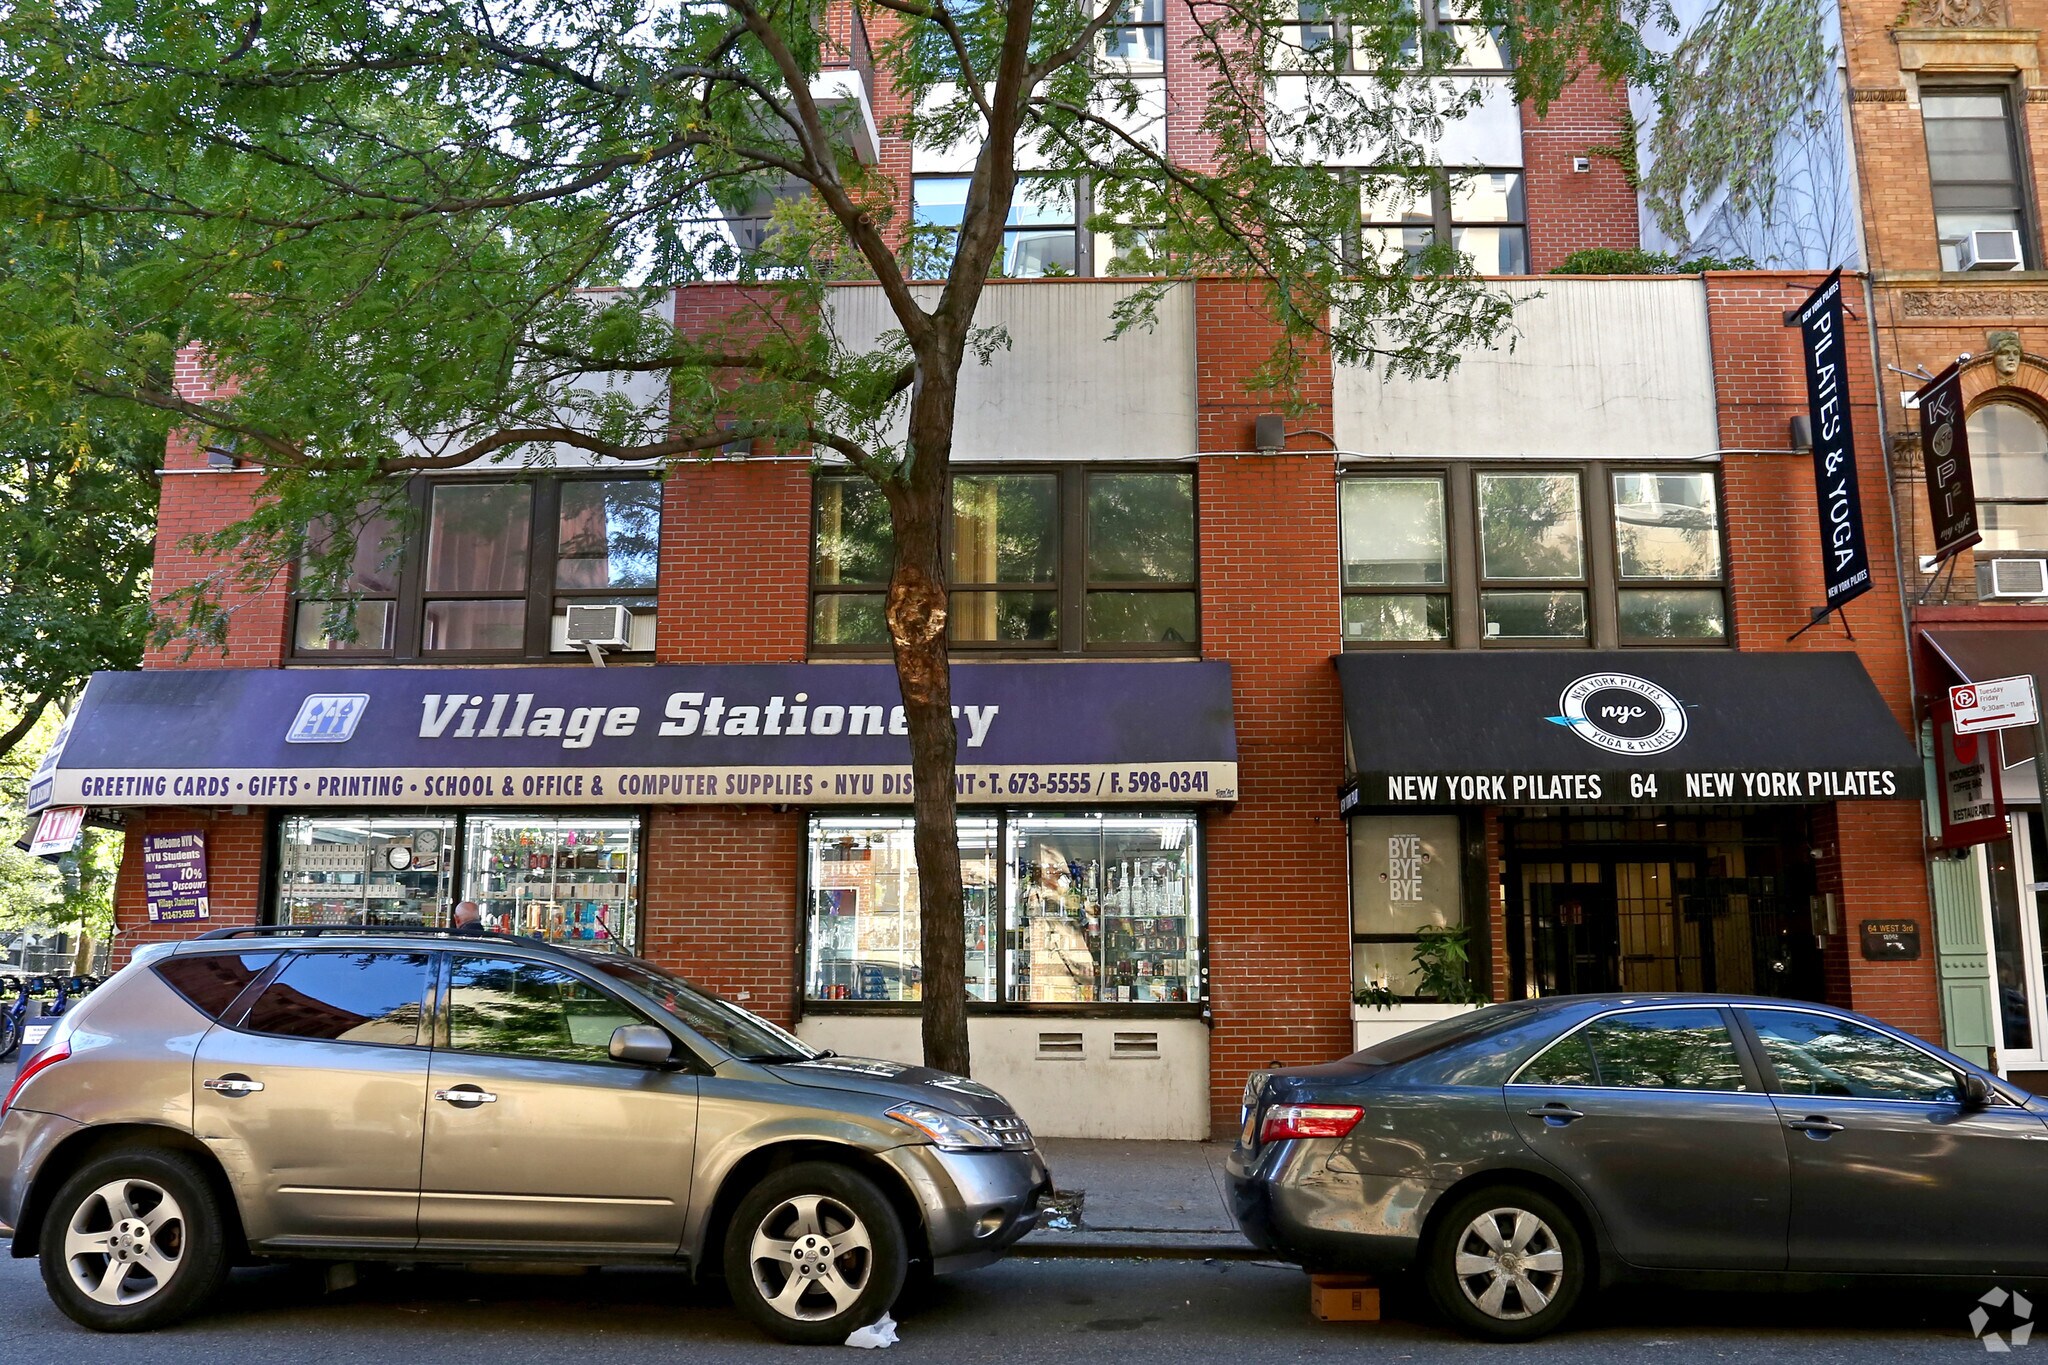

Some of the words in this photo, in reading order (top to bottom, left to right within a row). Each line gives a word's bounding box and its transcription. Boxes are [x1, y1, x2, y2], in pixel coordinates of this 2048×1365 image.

[1802, 308, 1812, 323] NEW
[1812, 297, 1823, 313] YORK
[1822, 281, 1839, 303] PILATES
[1813, 311, 1840, 441] PILATES
[1825, 448, 1843, 477] &
[1829, 478, 1854, 572] YOGA
[1828, 585, 1838, 598] NEW
[1839, 579, 1850, 592] YORK
[1850, 569, 1868, 586] PILATES
[1571, 684, 1590, 700] NEW
[1588, 678, 1617, 688] YORK
[1620, 678, 1664, 700] PILATES
[1979, 687, 2004, 695] Tuesday
[1601, 705, 1647, 724] nyc
[1981, 704, 2005, 712] 9:30am
[419, 694, 640, 749] Village
[1591, 731, 1622, 748] YOGA
[1627, 741, 1635, 750] &
[1639, 729, 1677, 750] PILATES
[1948, 764, 1985, 782] INDONESIAN
[82, 777, 167, 797] GREETING
[174, 776, 230, 797] CARDS
[249, 776, 298, 797] GIFTS
[317, 776, 404, 797] PRINTING
[424, 776, 494, 797] SCHOOL
[502, 776, 515, 797] &
[523, 776, 584, 797] OFFICE
[591, 775, 604, 796] &
[618, 775, 718, 796] COMPUTER
[726, 774, 813, 796] SUPPLIES
[834, 774, 874, 796] NYU
[882, 774, 976, 795] DISNT
[988, 773, 1004, 795] T.
[1008, 773, 1091, 795] 673-5555
[1111, 772, 1124, 794] F.
[1128, 771, 1209, 794] 598-0341
[1388, 776, 1439, 801] NEW
[1445, 775, 1507, 801] YORK
[1512, 774, 1602, 800] PILATES
[1631, 774, 1658, 799] 64
[1686, 773, 1735, 798] NEW
[1741, 771, 1803, 798] YORK
[1808, 770, 1896, 797] PILATES
[1953, 781, 1972, 793] COFFEE
[1971, 778, 1983, 789] BAR
[1953, 803, 1991, 821] RESTAURANT
[36, 808, 81, 842] ATM
[154, 837, 180, 849] Welcome
[181, 835, 193, 847] NYU
[1388, 838, 1421, 858] BYE
[145, 853, 161, 862] NYU
[162, 850, 200, 862] Students
[180, 867, 202, 880] 10%
[1389, 858, 1422, 879] BYE
[1390, 880, 1423, 900] BYE
[157, 898, 173, 908] Village
[161, 909, 195, 920] 212-673-5555
[1867, 924, 1877, 933] 64
[1880, 924, 1899, 932] WEST
[1902, 924, 1914, 932] 3rd
